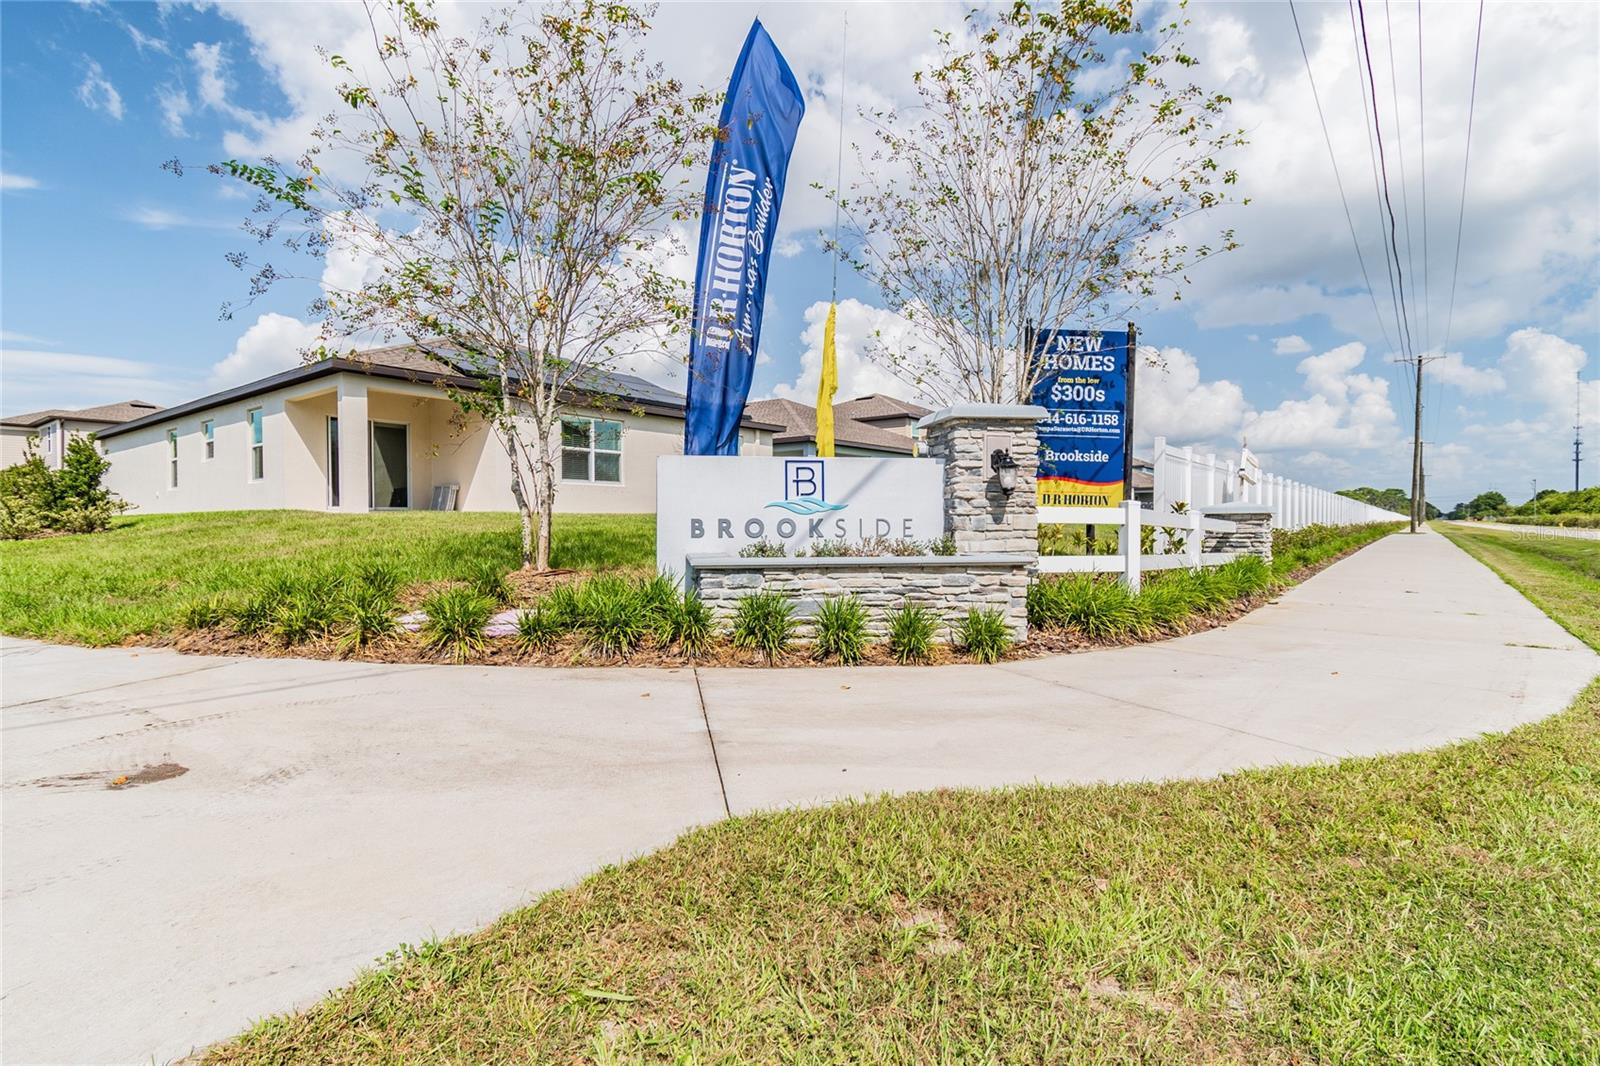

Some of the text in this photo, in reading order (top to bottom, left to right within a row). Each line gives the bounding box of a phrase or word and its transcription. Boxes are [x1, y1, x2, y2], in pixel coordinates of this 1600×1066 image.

[747, 177, 774, 254] Builder
[1056, 335, 1103, 352] NEW
[1043, 354, 1115, 371] HOMES
[1058, 376, 1074, 384] from
[1087, 376, 1100, 384] low
[1051, 383, 1106, 402] $300s
[1044, 450, 1110, 462] Brookside
[690, 518, 914, 539] BROOKSIDE
